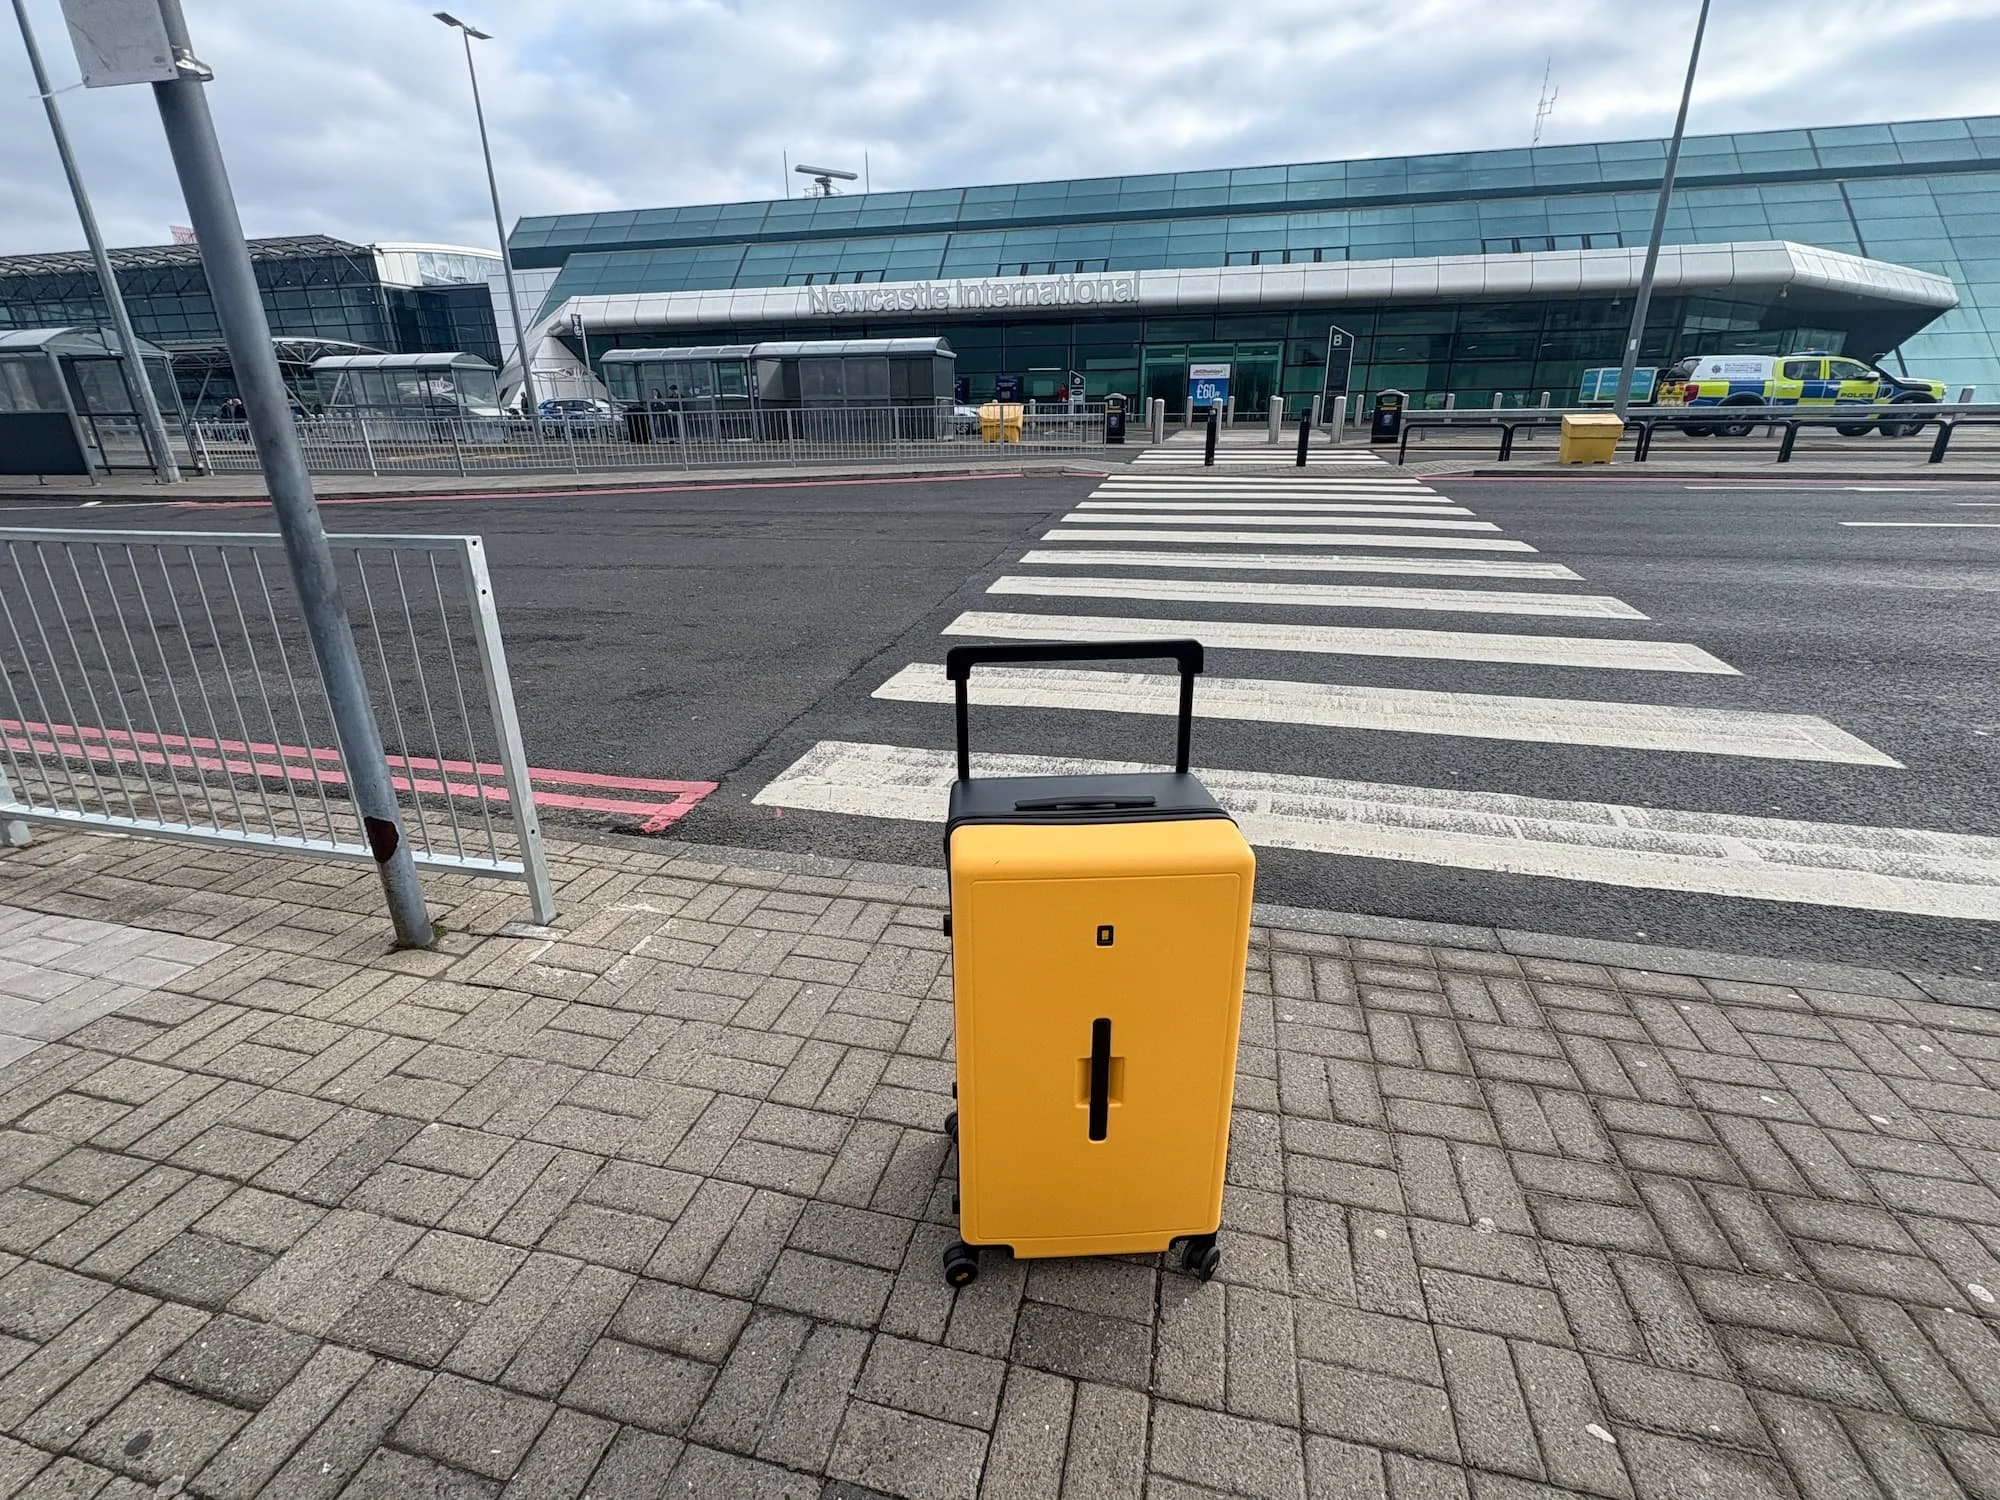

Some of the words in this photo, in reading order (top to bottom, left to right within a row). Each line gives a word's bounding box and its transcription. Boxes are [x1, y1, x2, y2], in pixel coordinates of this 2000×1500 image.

[807, 280, 949, 314] Newcastle
[956, 270, 1141, 308] International
[1333, 334, 1343, 346] B
[1196, 383, 1215, 399] £60
